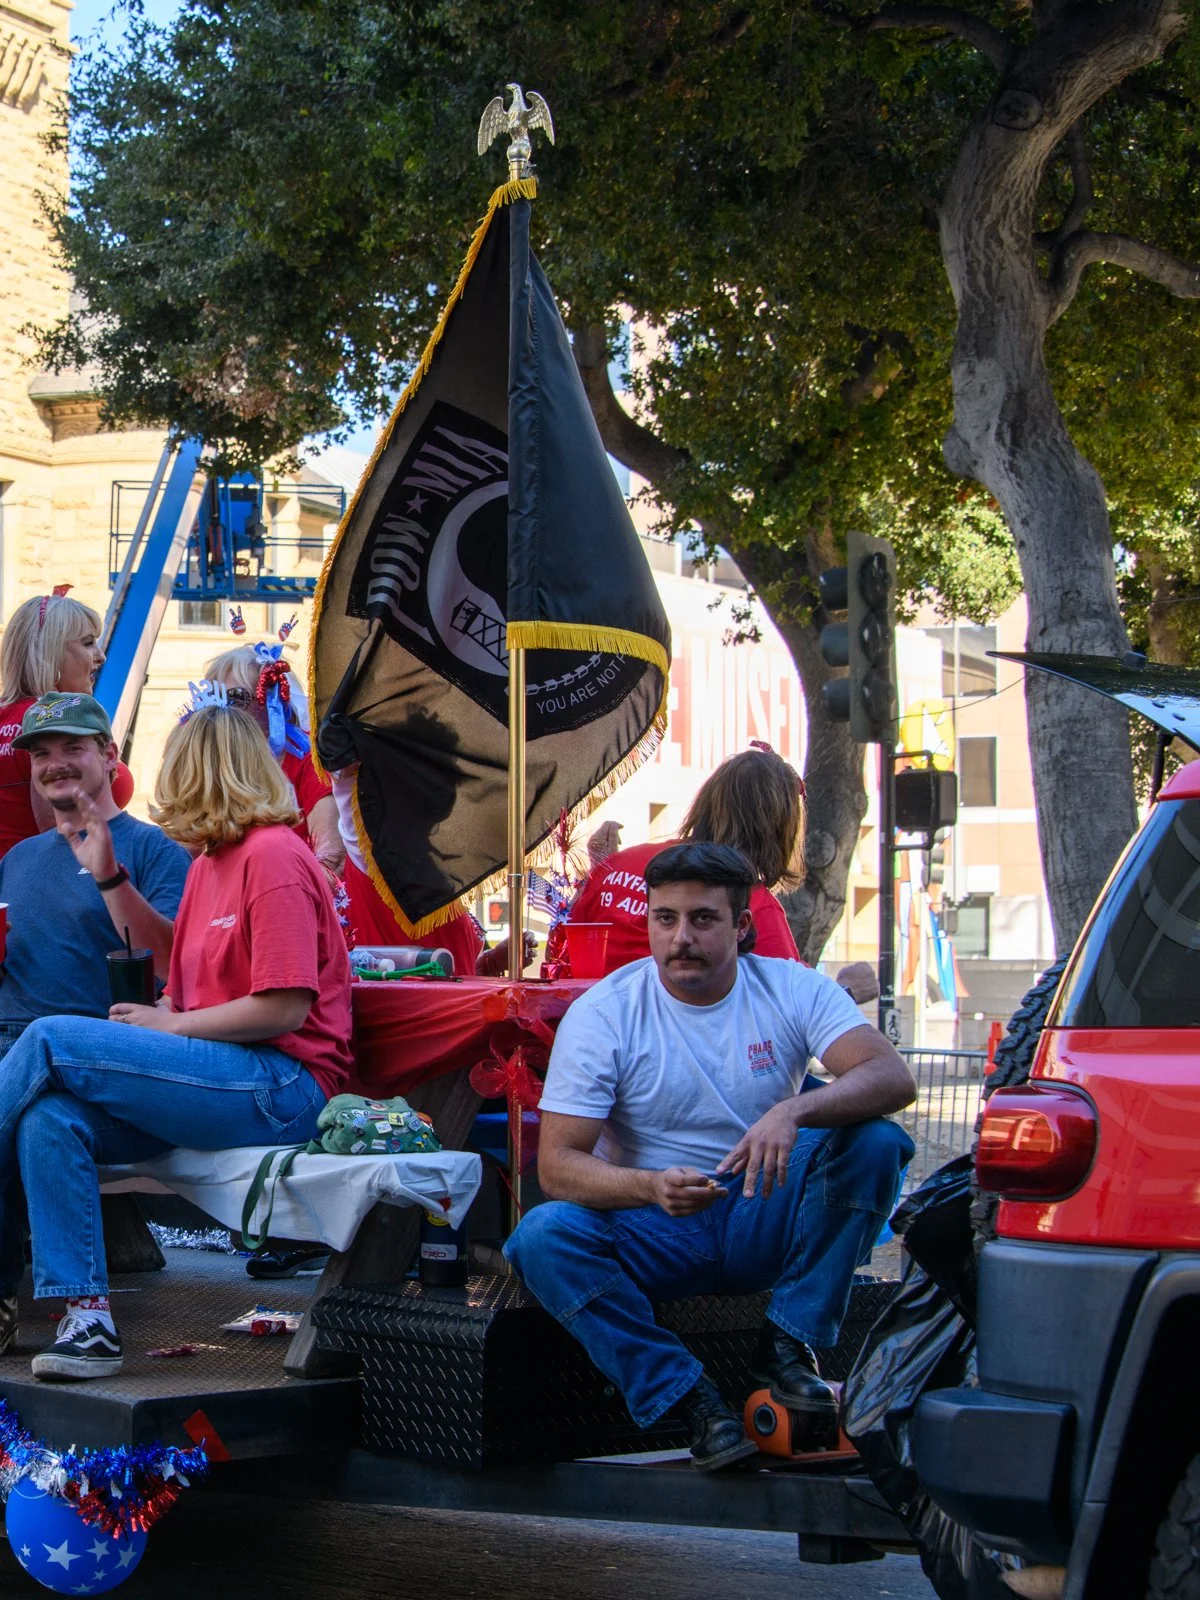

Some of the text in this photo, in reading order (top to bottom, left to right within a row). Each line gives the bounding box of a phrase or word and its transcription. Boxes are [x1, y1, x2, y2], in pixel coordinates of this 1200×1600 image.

[401, 424, 509, 502] MIA
[536, 660, 621, 715] YOU ARE NOT
[603, 871, 648, 894] MAYFA
